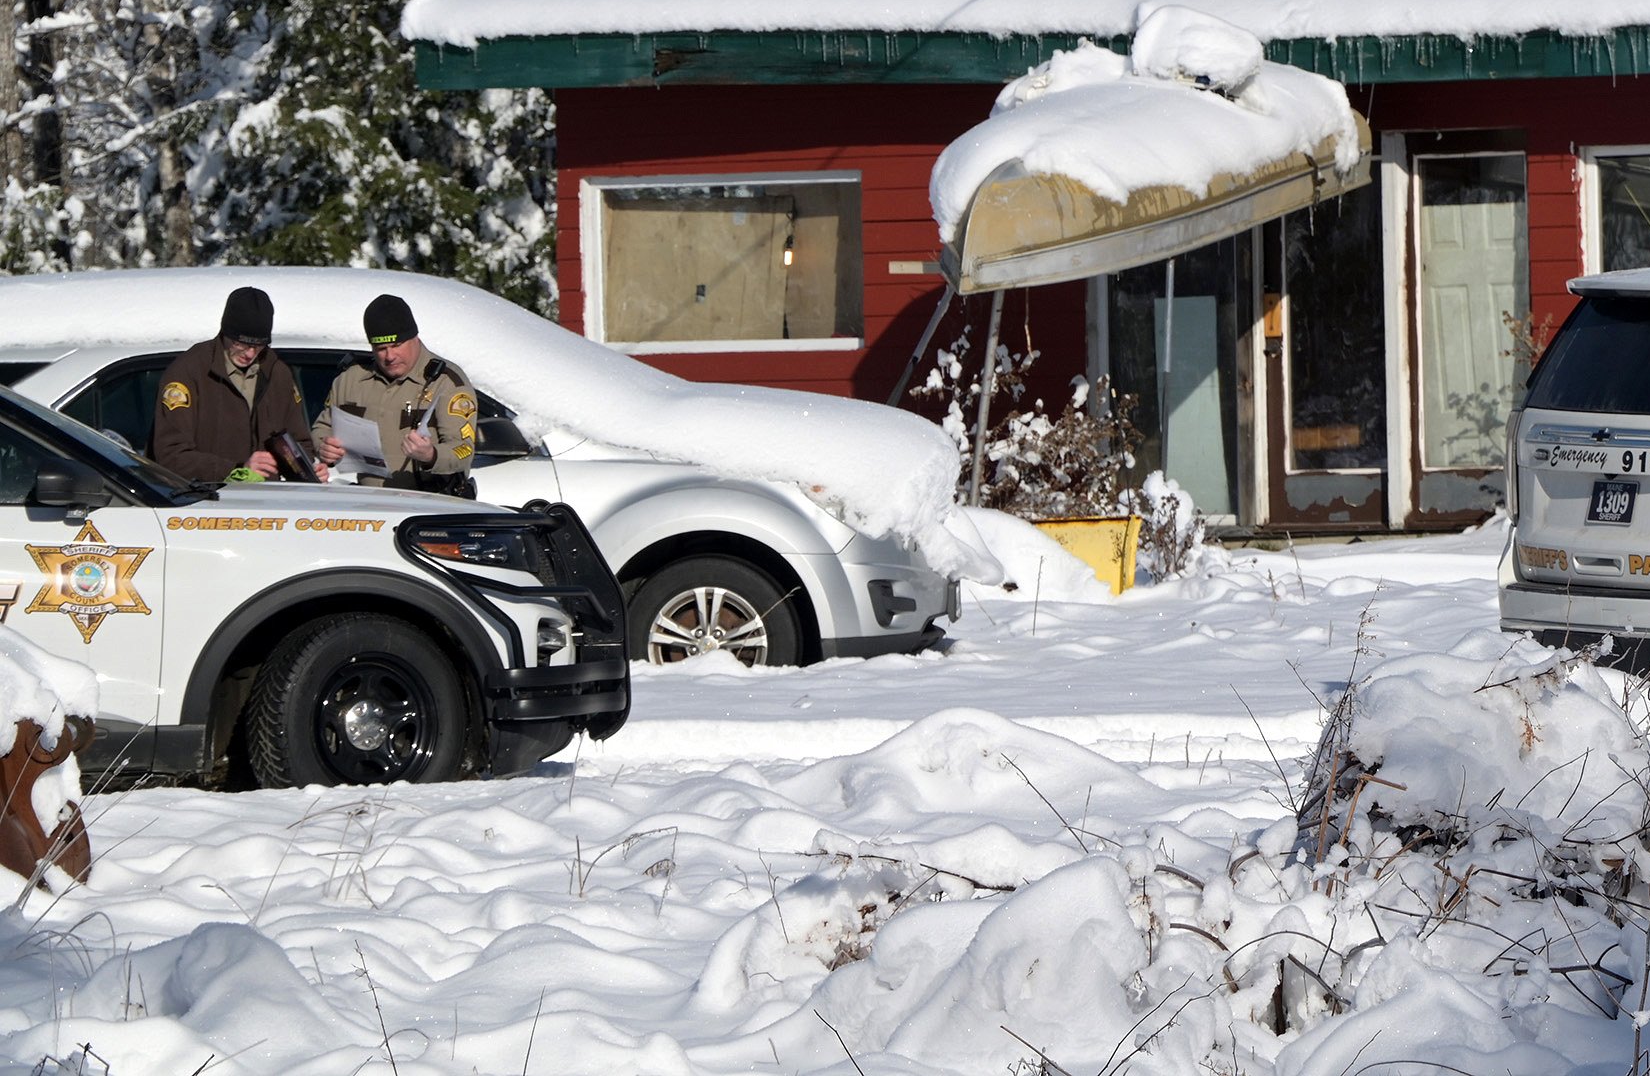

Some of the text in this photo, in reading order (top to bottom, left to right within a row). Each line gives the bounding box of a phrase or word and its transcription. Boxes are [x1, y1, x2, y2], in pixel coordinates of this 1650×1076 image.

[1550, 445, 1608, 469] Emergency
[1596, 490, 1630, 514] 1309
[1598, 512, 1622, 521] SHERIFF
[167, 516, 385, 532] SOMERSET COUNTY
[66, 545, 114, 556] SHERIFF
[66, 556, 110, 572] SOMERSET
[70, 592, 105, 605] COUNTY
[69, 604, 107, 613] OFFICE
